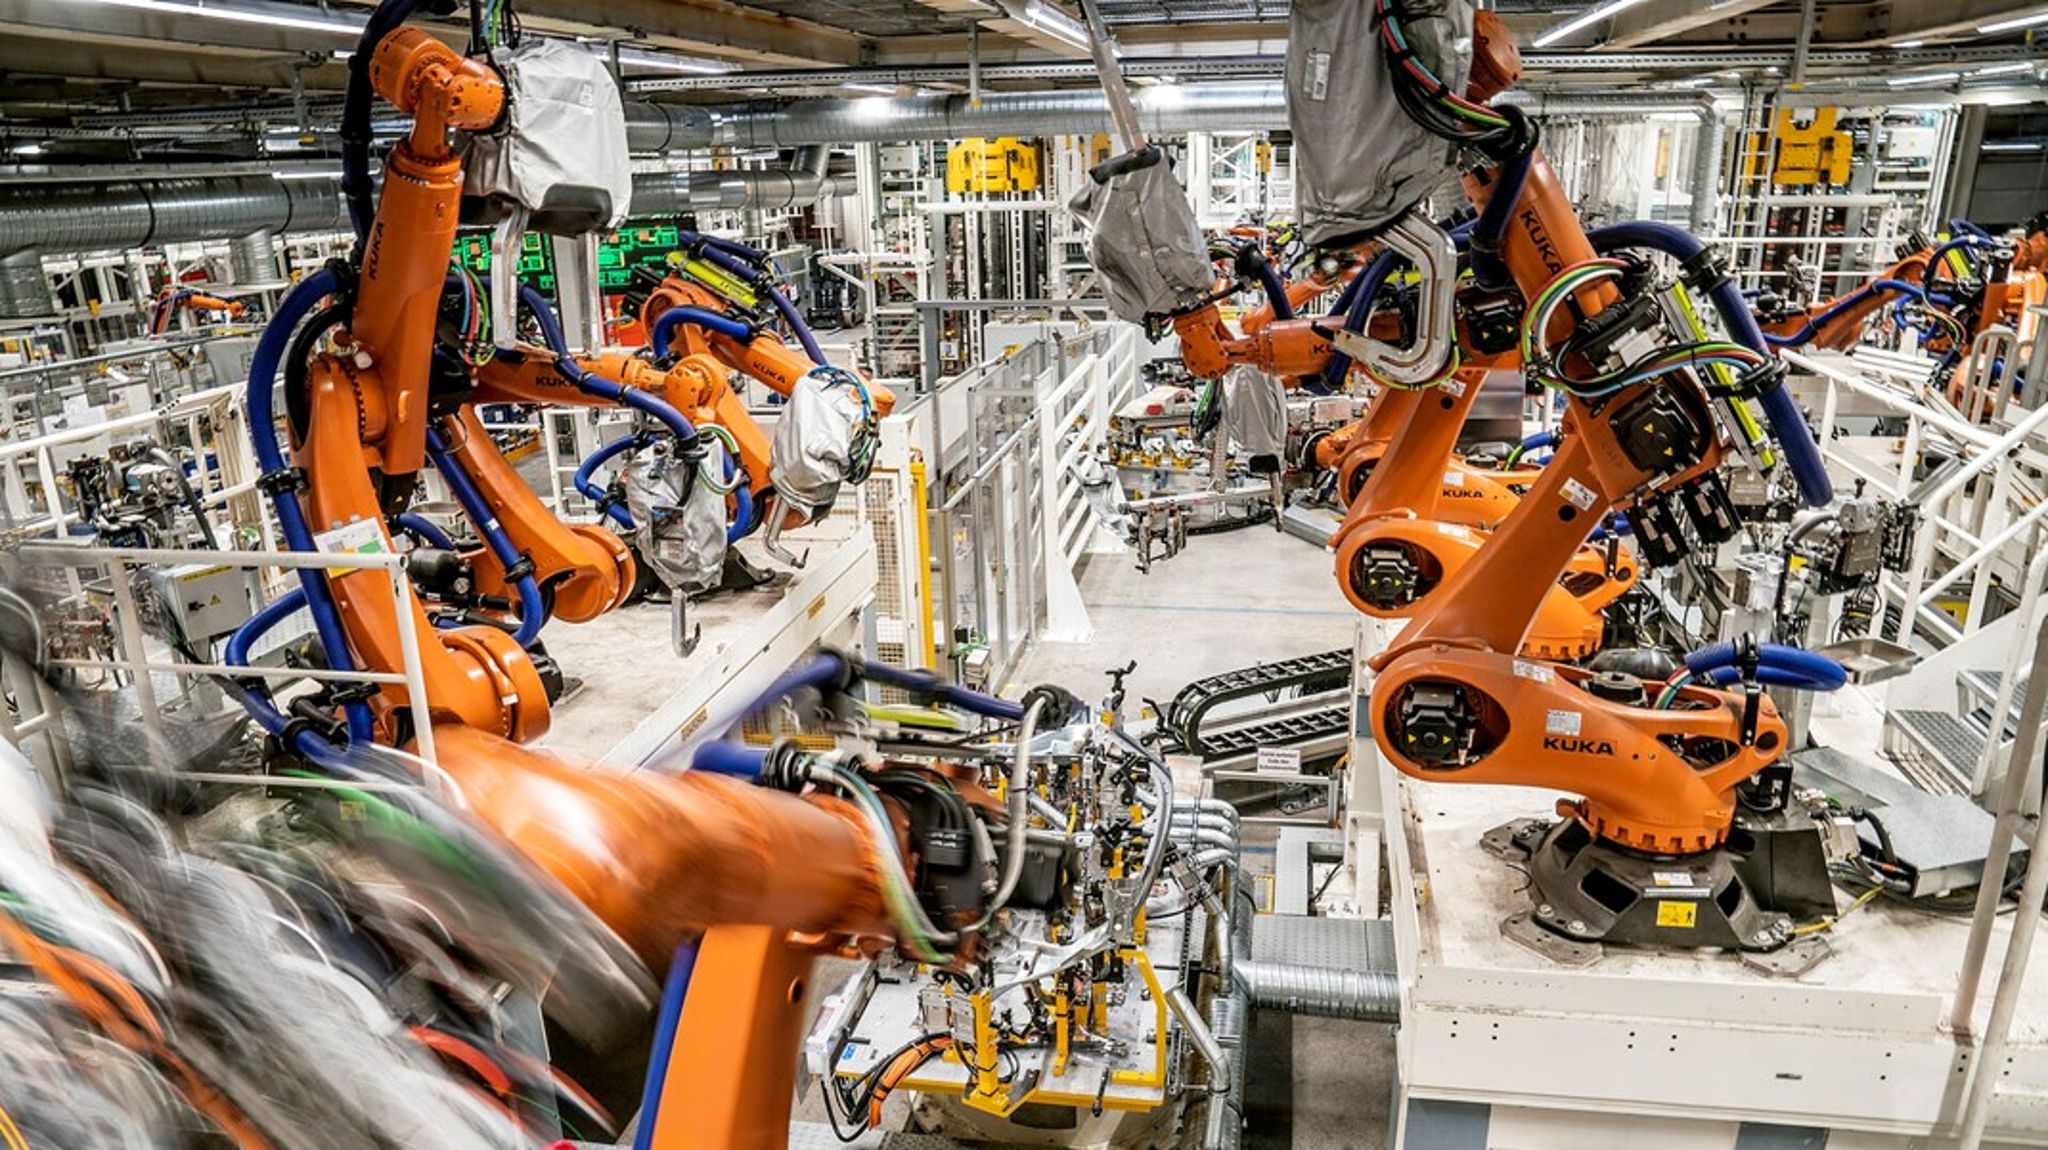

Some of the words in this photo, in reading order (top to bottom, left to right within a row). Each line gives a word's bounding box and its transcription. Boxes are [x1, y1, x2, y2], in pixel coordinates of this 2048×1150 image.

[368, 222, 384, 279] KUKA
[1520, 210, 1562, 275] KUKA
[753, 361, 786, 384] KUKA
[1442, 489, 1484, 498] KUKA
[1543, 737, 1614, 756] KUKA
